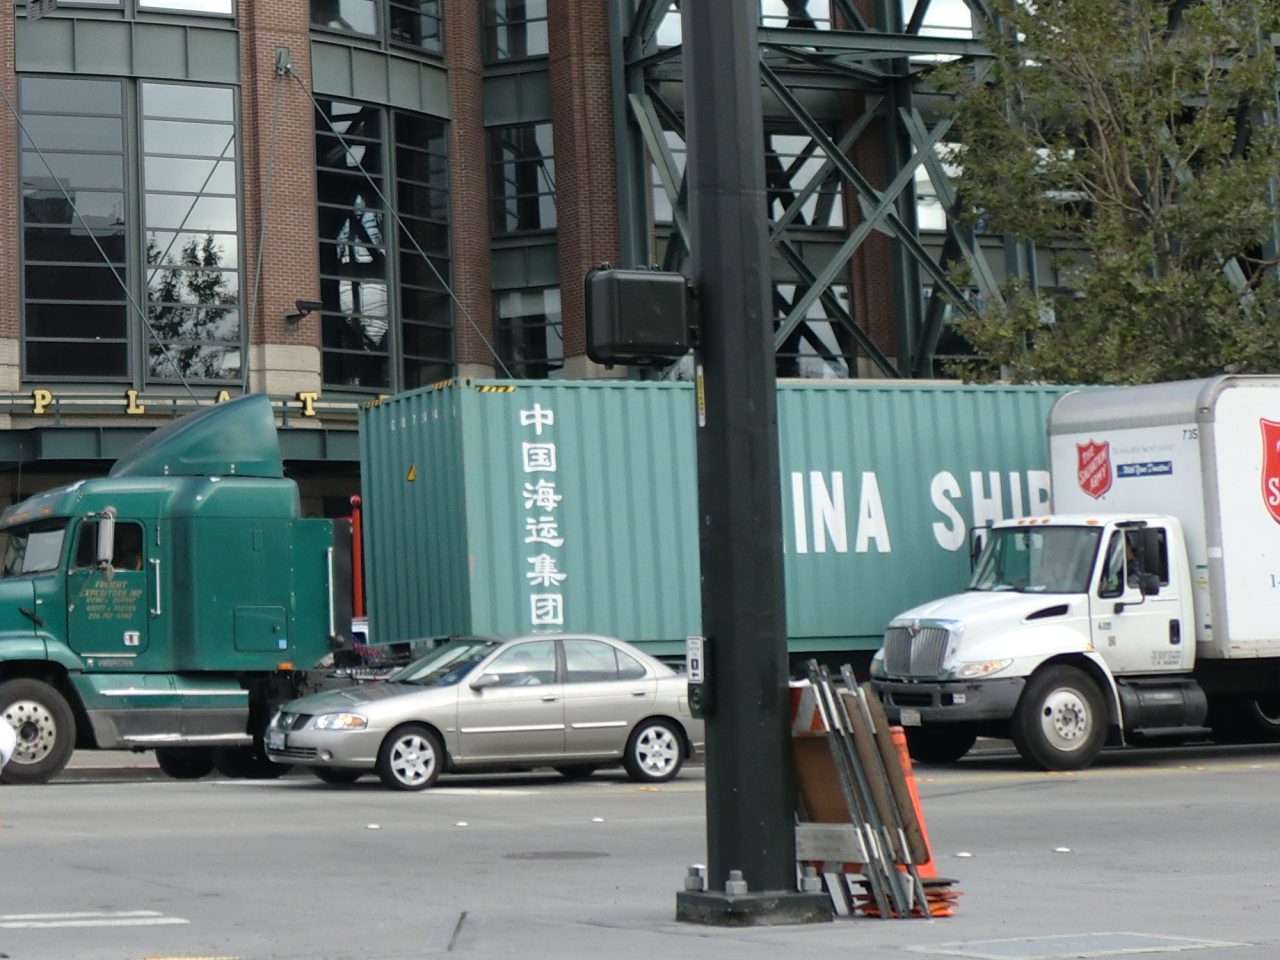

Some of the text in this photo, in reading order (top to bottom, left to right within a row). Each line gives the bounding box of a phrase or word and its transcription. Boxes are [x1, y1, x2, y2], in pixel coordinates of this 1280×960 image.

[1182, 428, 1198, 440] 735
[520, 404, 567, 625] 中国海运集团
[783, 471, 892, 554] INA
